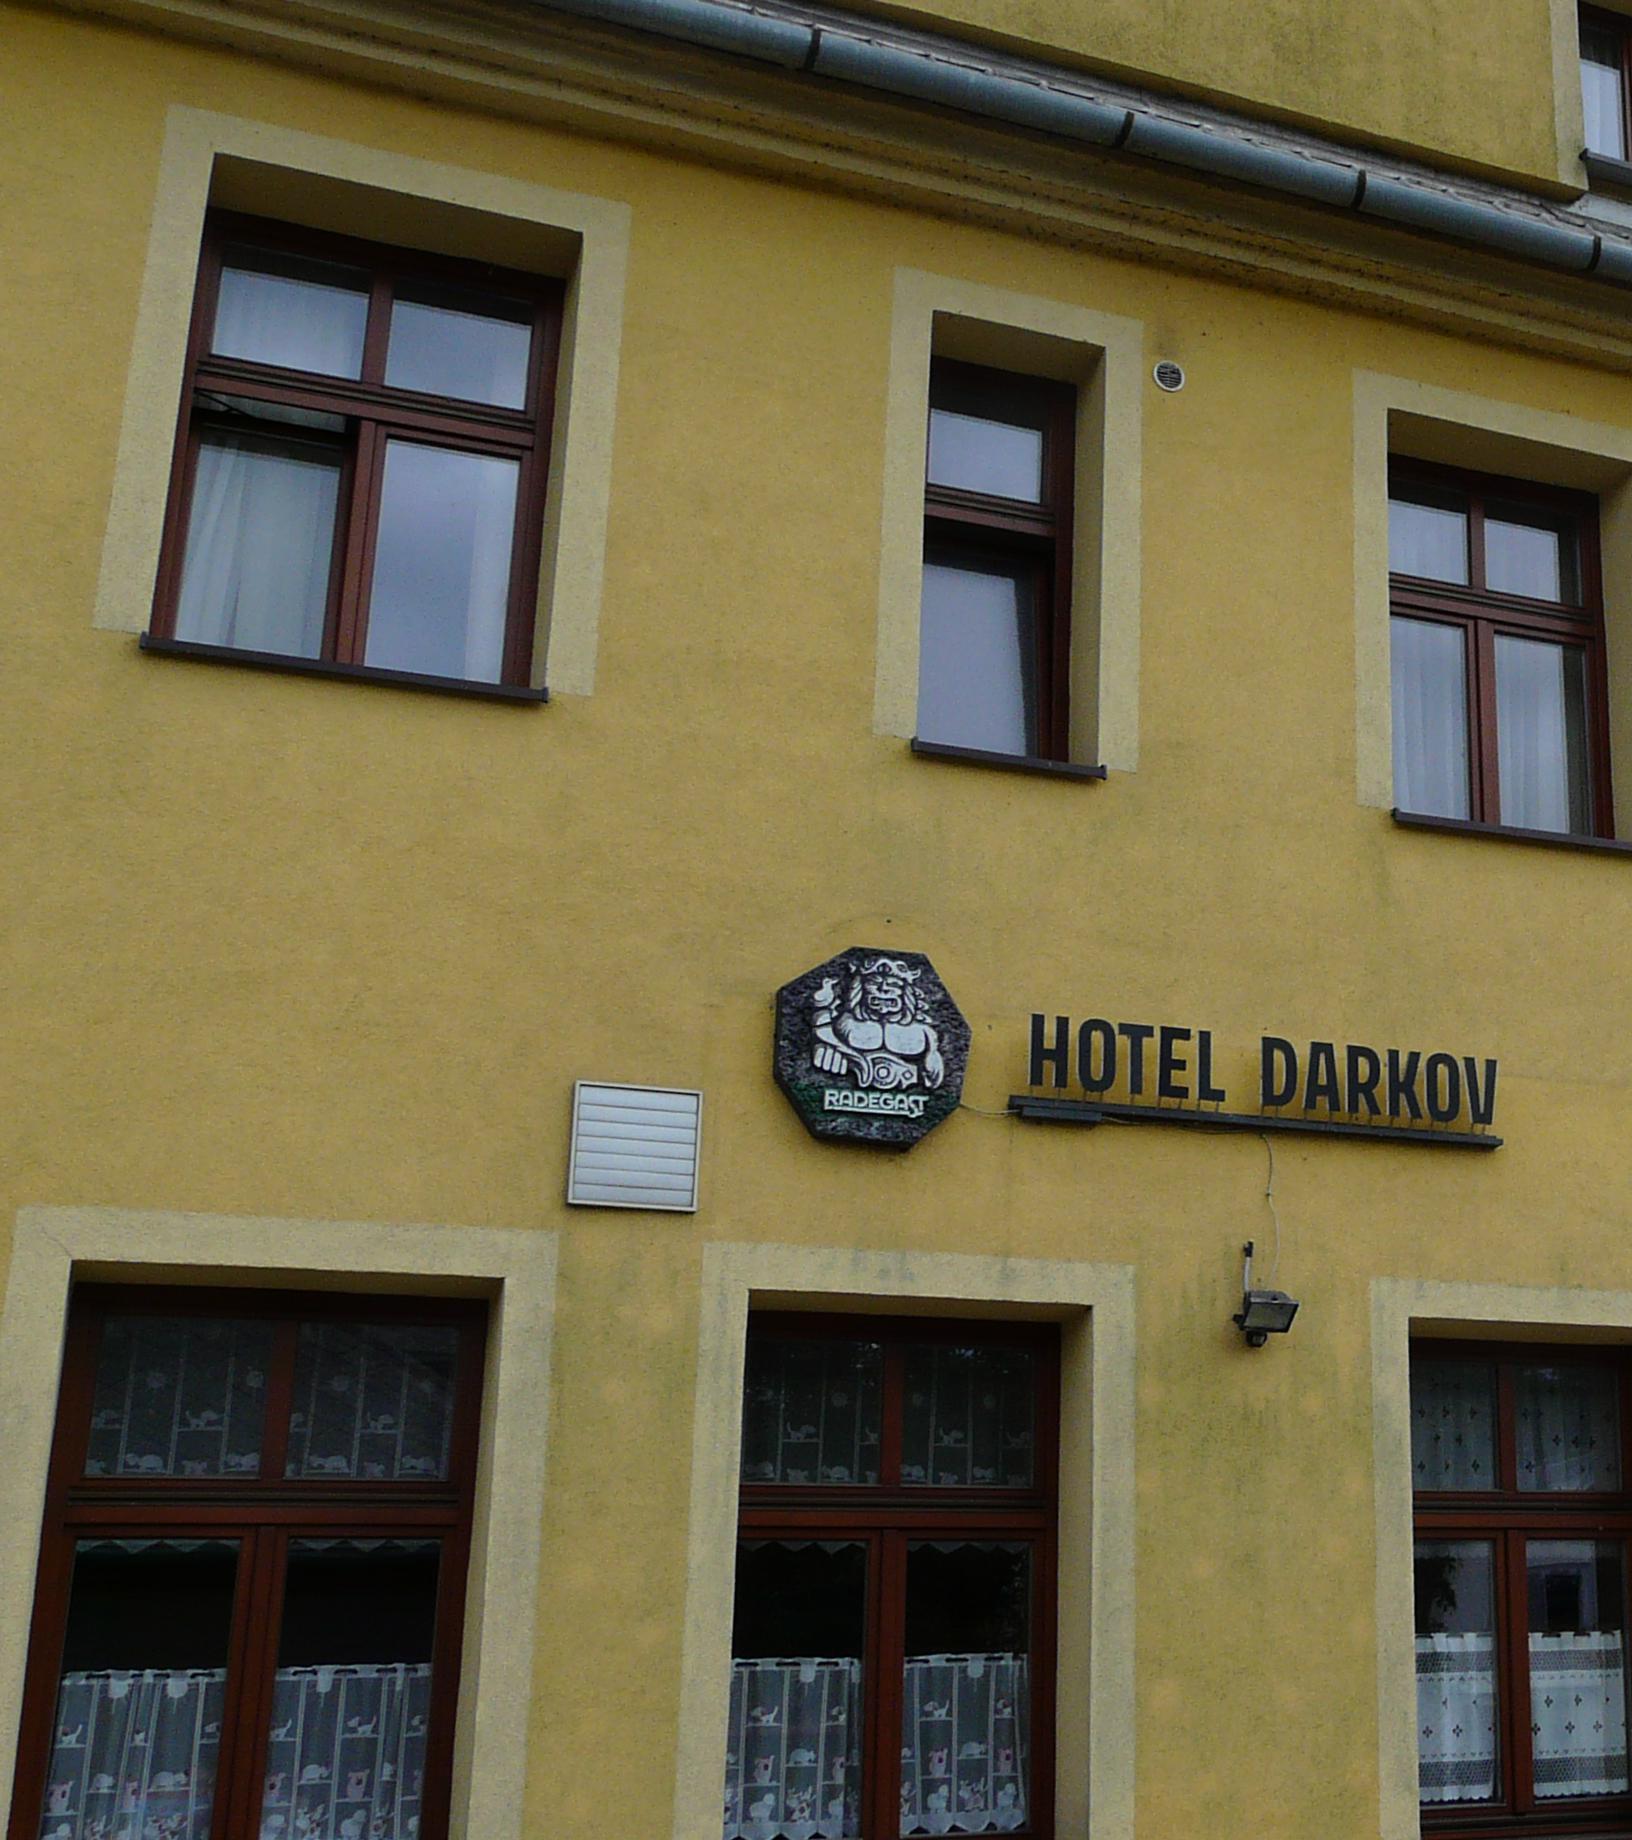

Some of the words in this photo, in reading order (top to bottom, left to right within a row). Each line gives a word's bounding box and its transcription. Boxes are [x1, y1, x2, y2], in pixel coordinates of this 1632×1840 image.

[824, 1089, 929, 1118] RADEGAST
[1029, 1013, 1226, 1102] HOTEL
[1261, 1036, 1498, 1125] DARKOV
